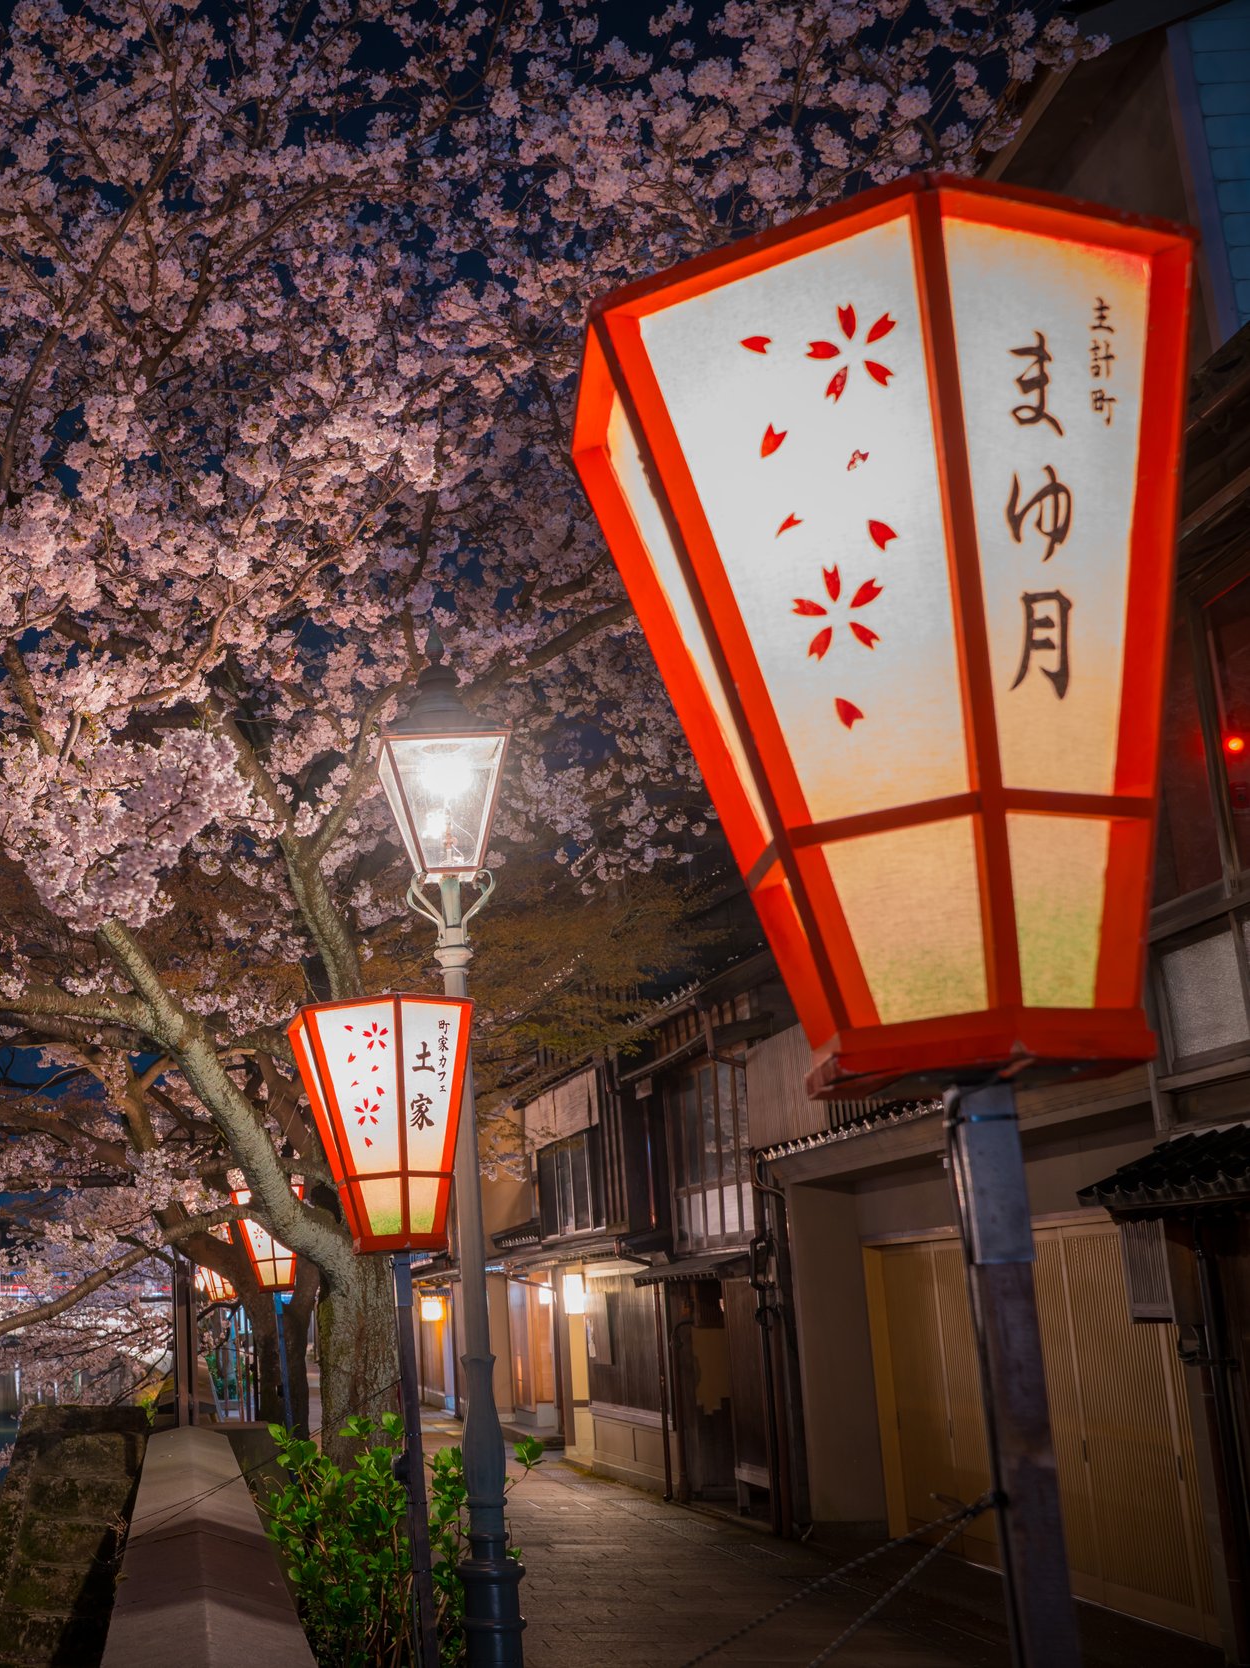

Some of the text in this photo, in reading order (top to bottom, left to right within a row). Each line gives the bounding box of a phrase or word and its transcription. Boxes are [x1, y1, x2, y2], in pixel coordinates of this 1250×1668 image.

[1089, 297, 1117, 426] 主計町
[1006, 331, 1073, 700] まゆ月
[410, 1041, 436, 1131] 土家
[437, 1019, 451, 1093] 町家カフェ
